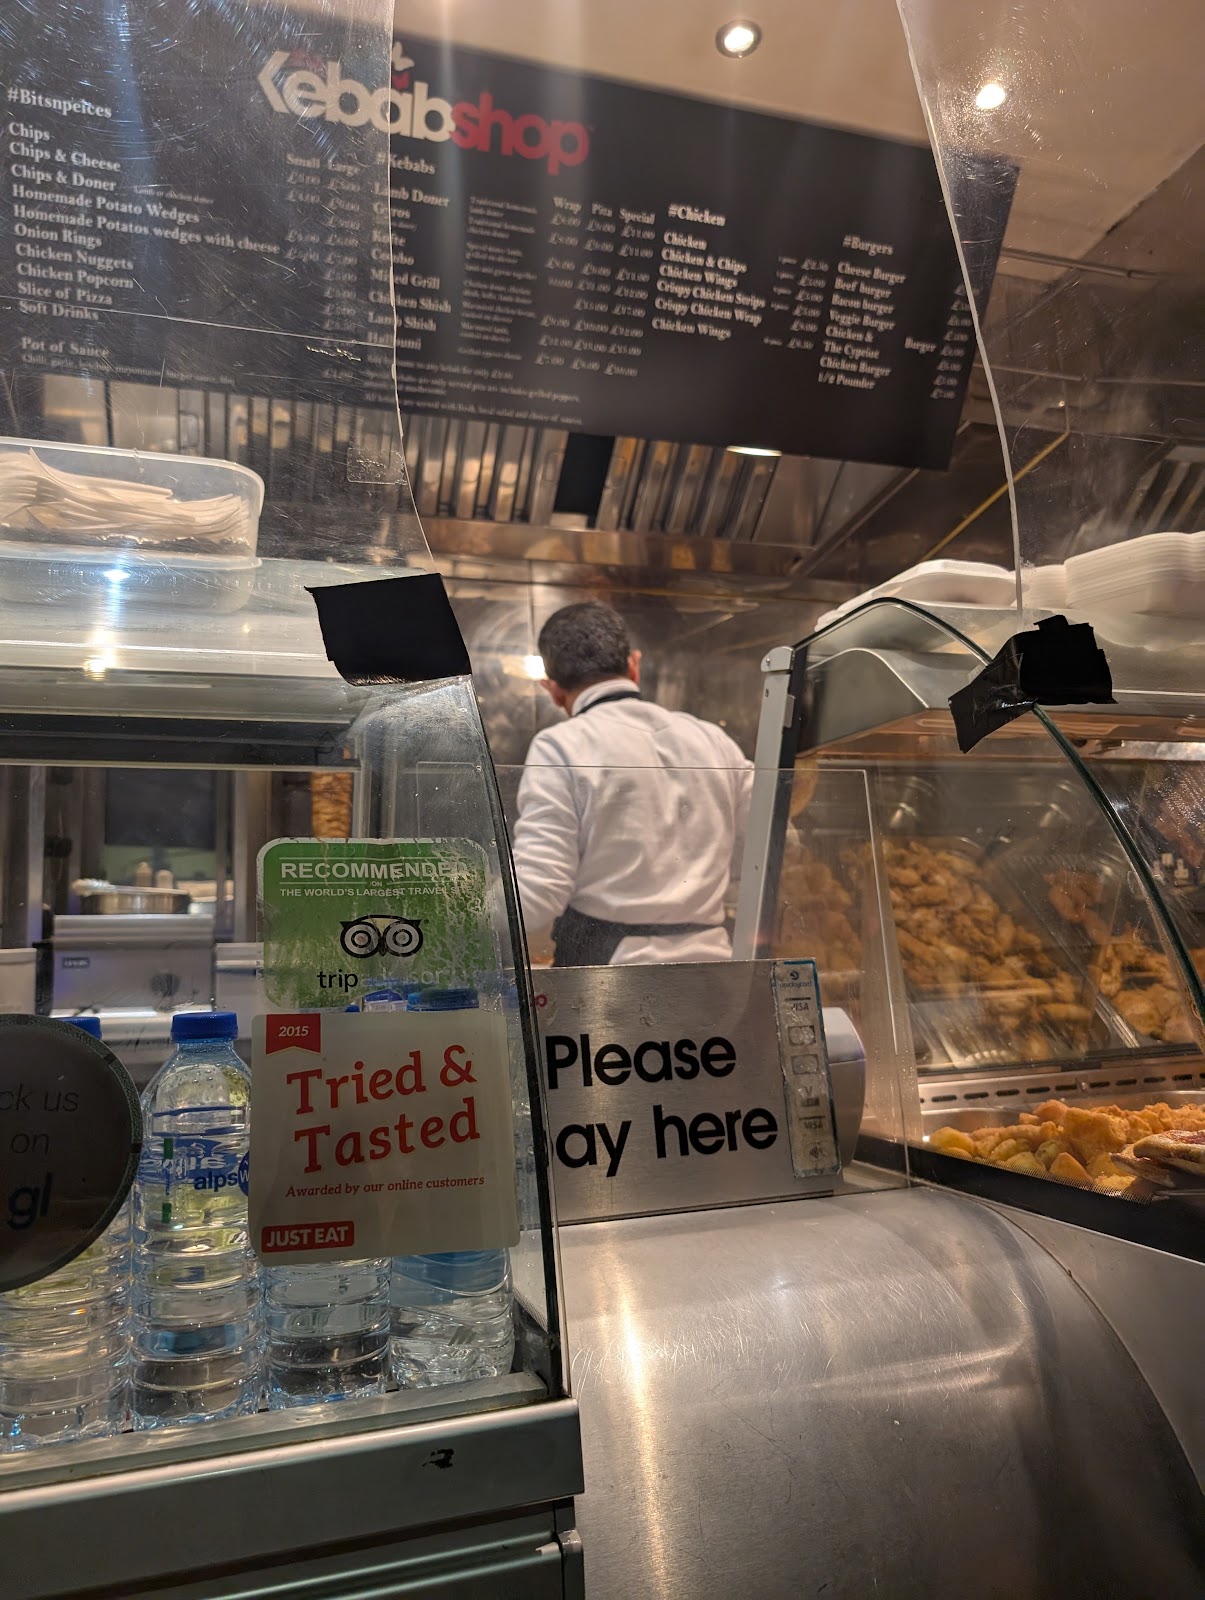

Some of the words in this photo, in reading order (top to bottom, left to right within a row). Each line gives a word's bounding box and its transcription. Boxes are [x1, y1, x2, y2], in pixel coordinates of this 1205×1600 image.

[7, 87, 112, 118] #Bitsnpeices
[9, 122, 50, 143] Chips
[9, 142, 51, 162] Chips
[55, 149, 67, 162] &
[71, 151, 121, 172] Cheese
[11, 164, 52, 184] Chips
[55, 171, 67, 184] &
[72, 172, 116, 191] Doner
[12, 184, 93, 207] Homemade
[96, 196, 142, 215] Potato
[146, 203, 199, 225] Wedges
[412, 189, 449, 207] Doner
[553, 197, 582, 214] Wrap
[668, 203, 726, 227] #Chicken
[13, 204, 93, 227] Homemade
[96, 216, 149, 235] Potatos
[153, 227, 201, 244] wedges
[204, 233, 234, 248] with
[237, 236, 280, 254] cheese
[14, 223, 58, 241] Onion
[62, 229, 102, 250] Rings
[664, 230, 707, 250] Chicken
[842, 234, 894, 256] #Burgers
[16, 243, 72, 262] Chicken
[76, 251, 134, 271] Nuggets
[661, 246, 705, 267] Chicken
[705, 253, 716, 268] &
[717, 256, 748, 276] Chips
[17, 262, 73, 281] Chicken
[77, 269, 134, 289] Popcorn
[370, 268, 408, 286] Mied
[659, 263, 702, 282] Chicken
[704, 269, 738, 290] Wings
[838, 261, 872, 278] Cheese
[873, 267, 907, 286] Burger
[17, 282, 52, 298] Slice
[55, 287, 71, 300] of
[76, 288, 112, 305] Pizza
[368, 289, 418, 309] Chiken
[657, 278, 692, 298] Crispy
[692, 284, 734, 304] Chicken
[834, 276, 859, 292] Beef
[859, 281, 892, 300] burger
[20, 300, 47, 315] Soft
[51, 303, 99, 320] Drinks
[655, 296, 690, 317] Crispy
[691, 301, 732, 320] Chicken
[734, 308, 762, 327] Wrap
[831, 292, 861, 309] Bacon
[862, 297, 895, 315] burger
[652, 316, 695, 334] Chicken
[697, 322, 732, 341] Wings
[829, 309, 862, 327] Veggie
[862, 314, 896, 332] Burger
[21, 336, 45, 351] Pot
[49, 341, 65, 354] of
[69, 343, 109, 358] Sauce
[823, 339, 842, 353] The
[825, 324, 864, 342] Chicken
[904, 335, 937, 354] Burger
[820, 355, 858, 372] Chicken
[859, 360, 891, 378] Burger
[836, 373, 876, 390] Pounder
[280, 888, 302, 897] THE
[304, 888, 354, 897] WORLD'S
[356, 886, 406, 898] LARGEST
[278, 1025, 309, 1038] 2015
[545, 1034, 736, 1090] Please
[286, 1051, 427, 1116] Tried
[439, 1044, 477, 1088] &
[44, 1092, 79, 1112] us
[10, 1132, 49, 1154] on
[294, 1096, 481, 1174] Tasted
[550, 1121, 632, 1178] ay
[653, 1104, 778, 1159] here
[194, 1171, 238, 1193] alps
[285, 1183, 342, 1198] Awarded
[346, 1182, 360, 1196] by
[363, 1182, 385, 1193] our
[387, 1178, 424, 1191] online
[425, 1175, 485, 1189] customers
[266, 1227, 311, 1248] JUST
[315, 1226, 349, 1243] EAT
